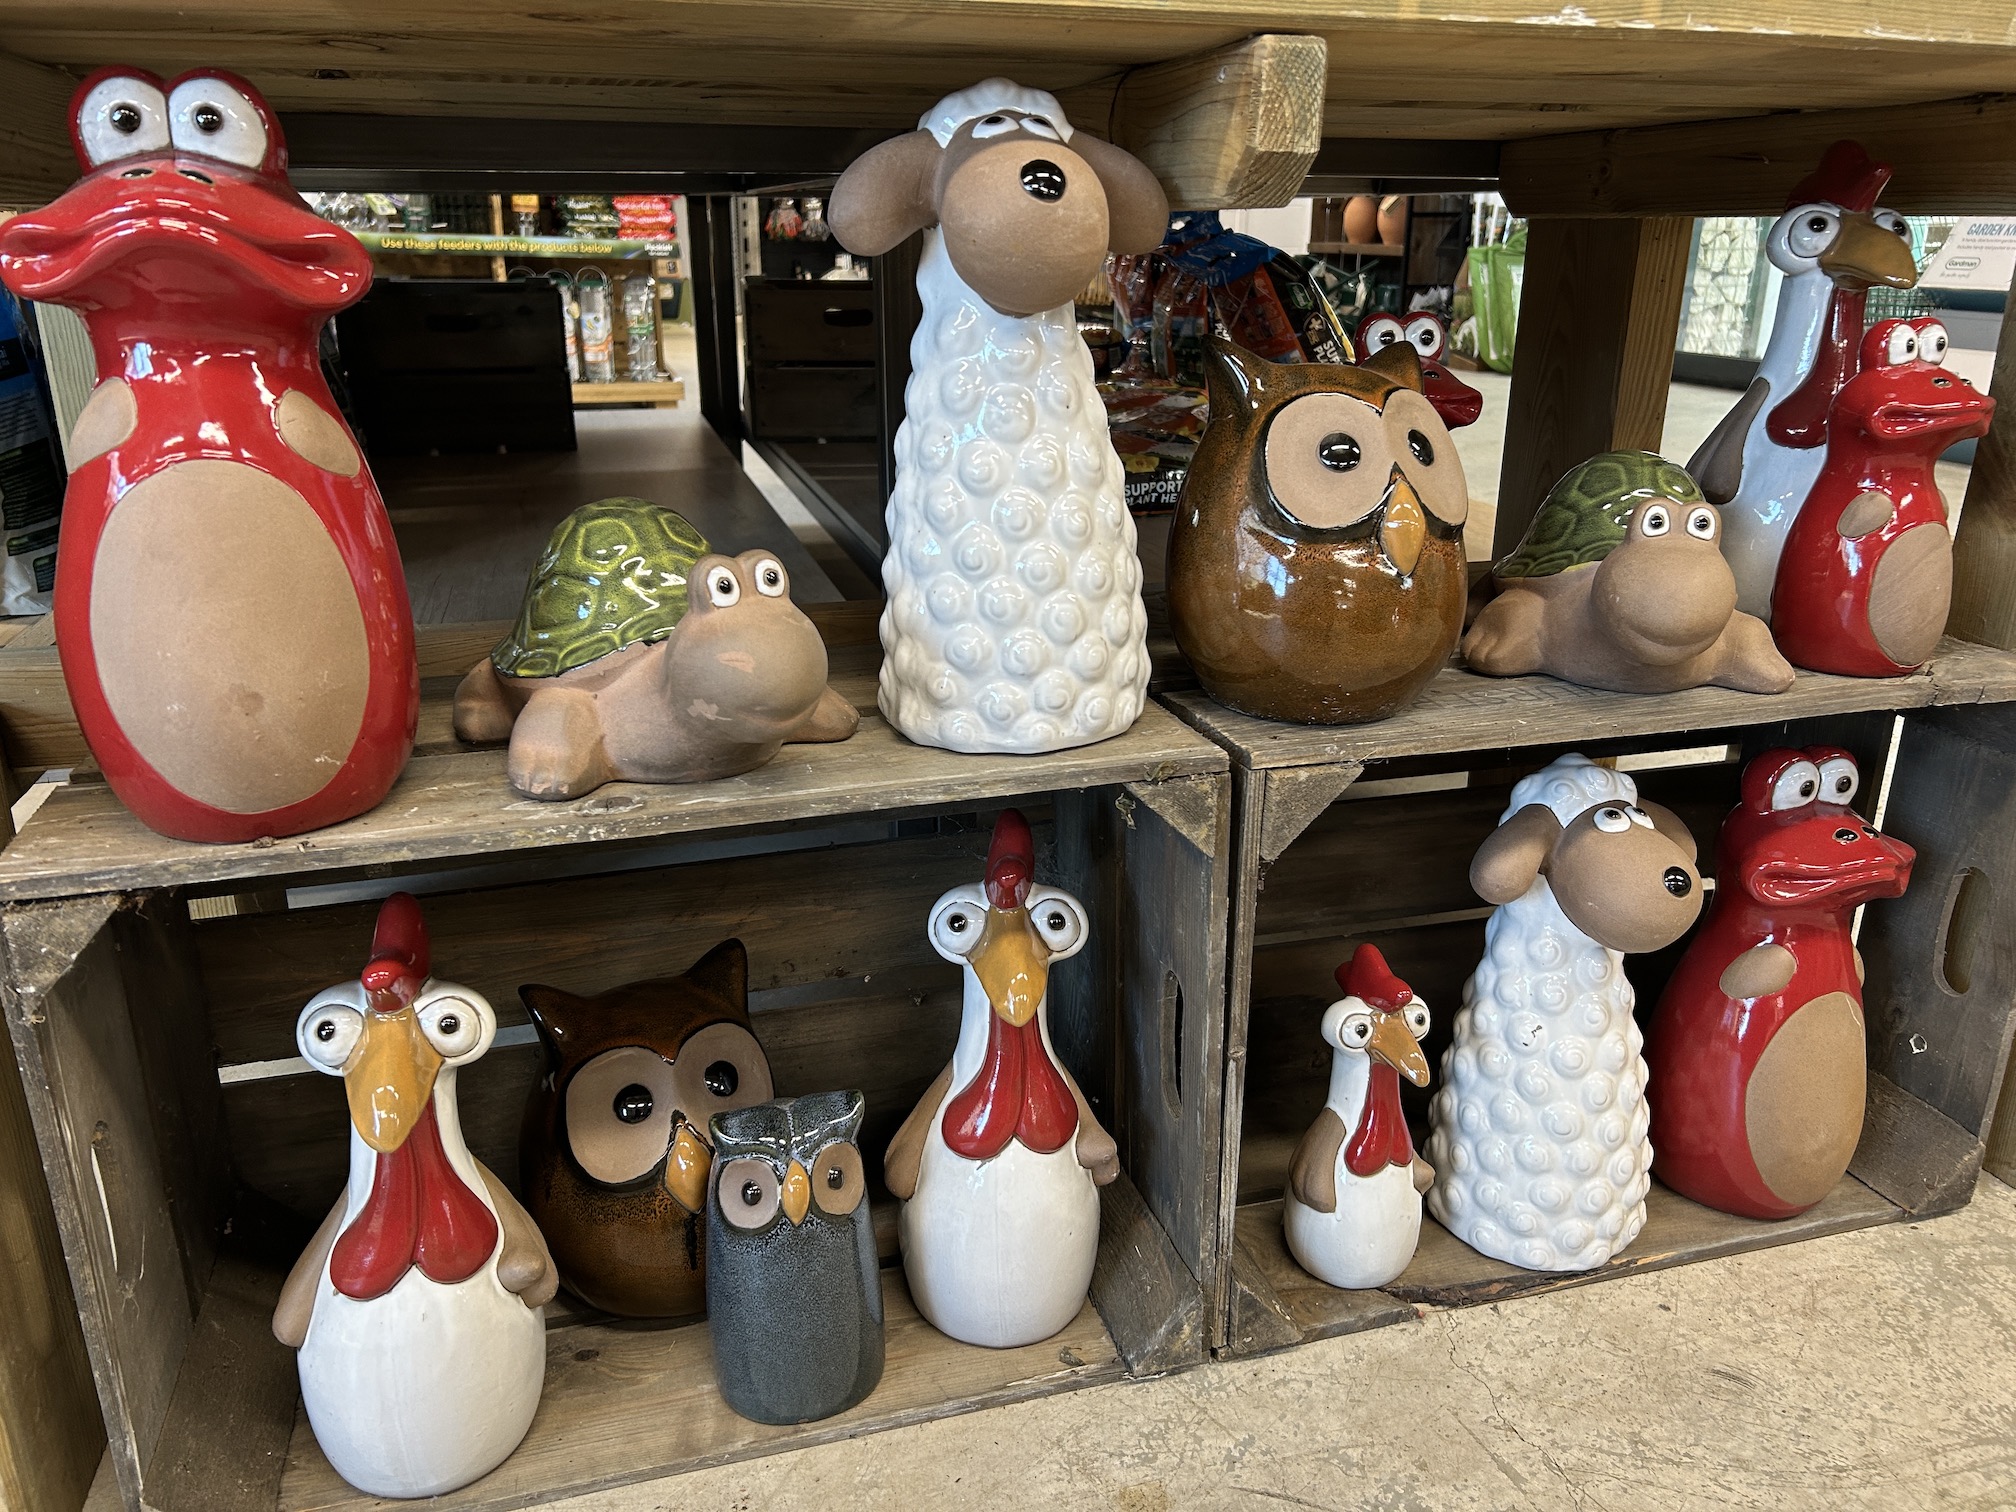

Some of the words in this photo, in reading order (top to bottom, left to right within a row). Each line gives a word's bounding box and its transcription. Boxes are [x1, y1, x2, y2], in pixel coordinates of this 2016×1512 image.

[1966, 223, 2005, 236] GARDEN
[381, 237, 404, 249] Use
[404, 238, 438, 250] these
[438, 239, 482, 251] feeders
[482, 239, 508, 251] with
[508, 240, 528, 251] the
[528, 241, 579, 254] products
[580, 242, 613, 254] below
[1125, 480, 1184, 497] SUPPORT
